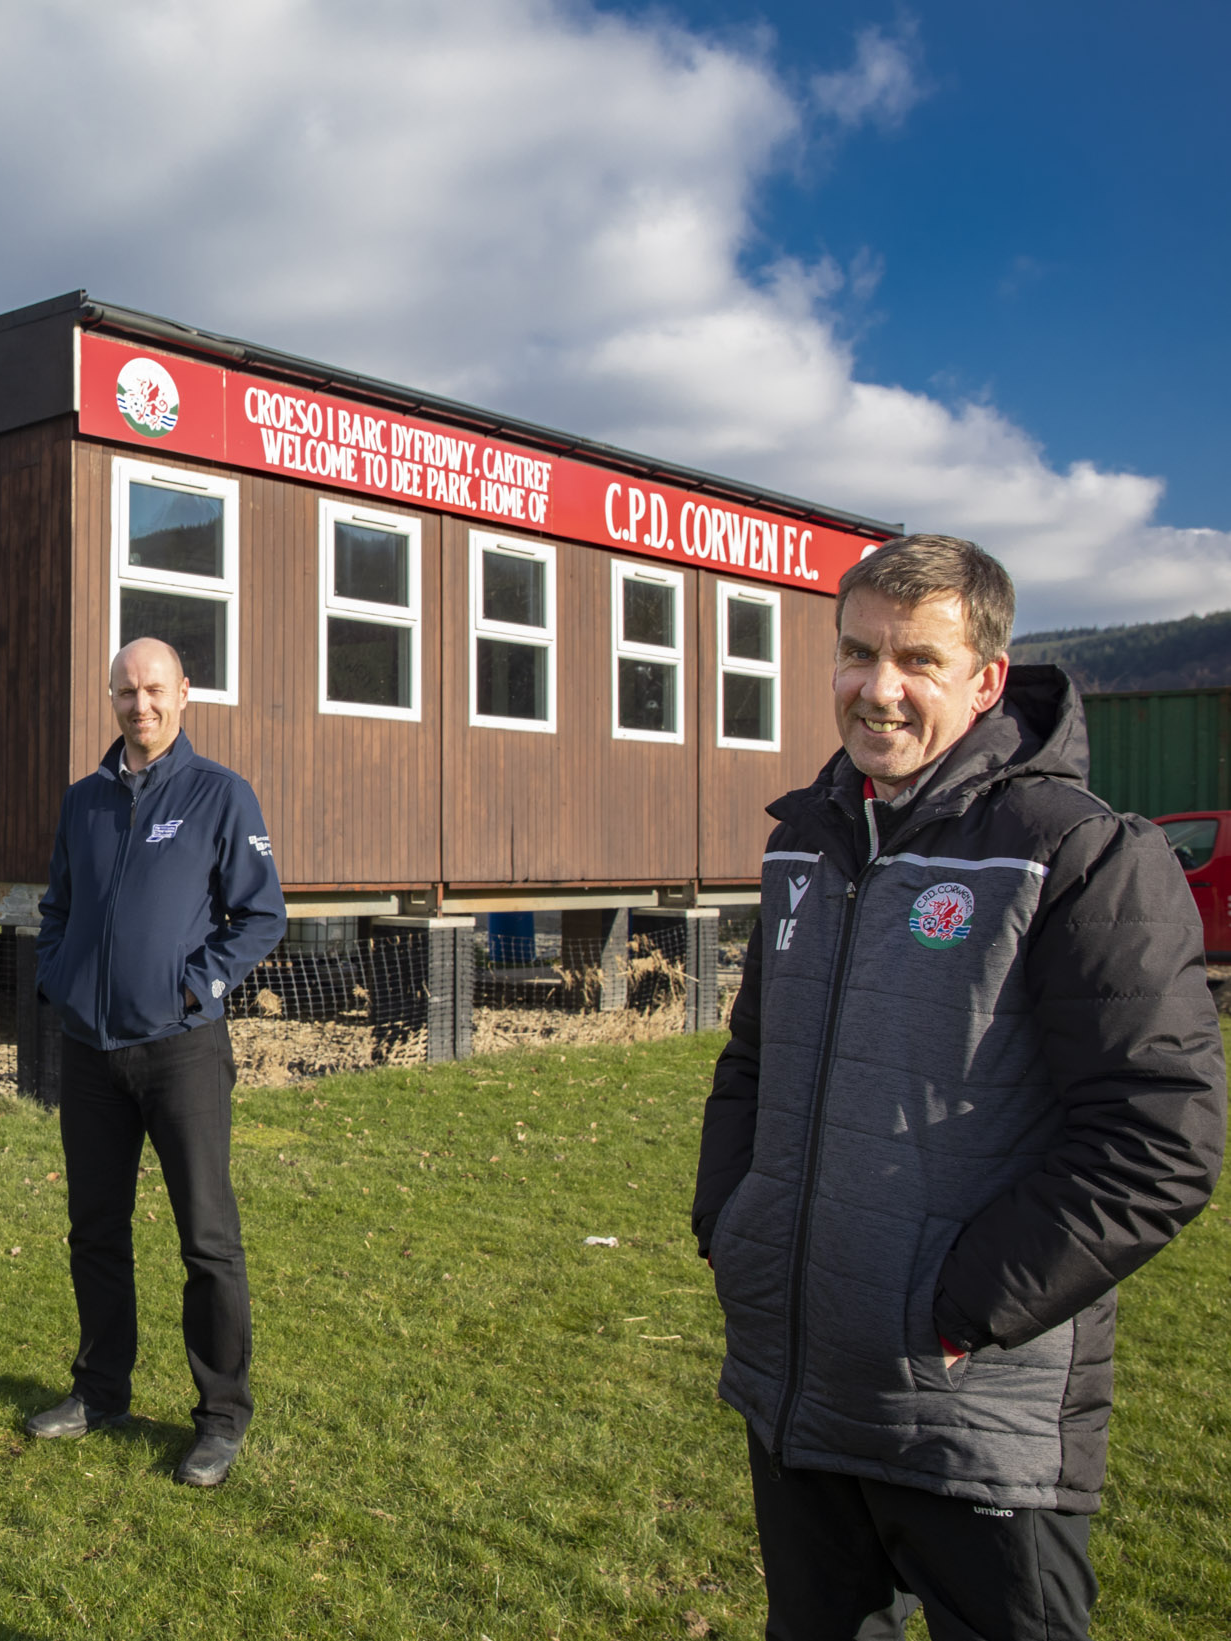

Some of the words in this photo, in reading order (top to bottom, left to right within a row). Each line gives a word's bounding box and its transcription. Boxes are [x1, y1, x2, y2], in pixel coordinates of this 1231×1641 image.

[245, 387, 323, 438] CROESO
[327, 406, 334, 441] I
[338, 409, 388, 454] BARC
[391, 423, 480, 477] DYFRDWY,
[482, 447, 552, 493] CARTREF
[260, 427, 358, 483] WELCOME
[361, 451, 388, 489] TO
[391, 458, 423, 497] DEE
[426, 467, 477, 510] PARK,
[480, 479, 526, 520] HOME
[528, 491, 549, 524] OF
[604, 482, 675, 551] C.P.D.
[679, 501, 779, 574] CORWEN
[783, 525, 819, 581] F.C.
[937, 884, 971, 902] CORWEN
[775, 918, 798, 951] IE
[973, 1506, 1014, 1518] umbro
